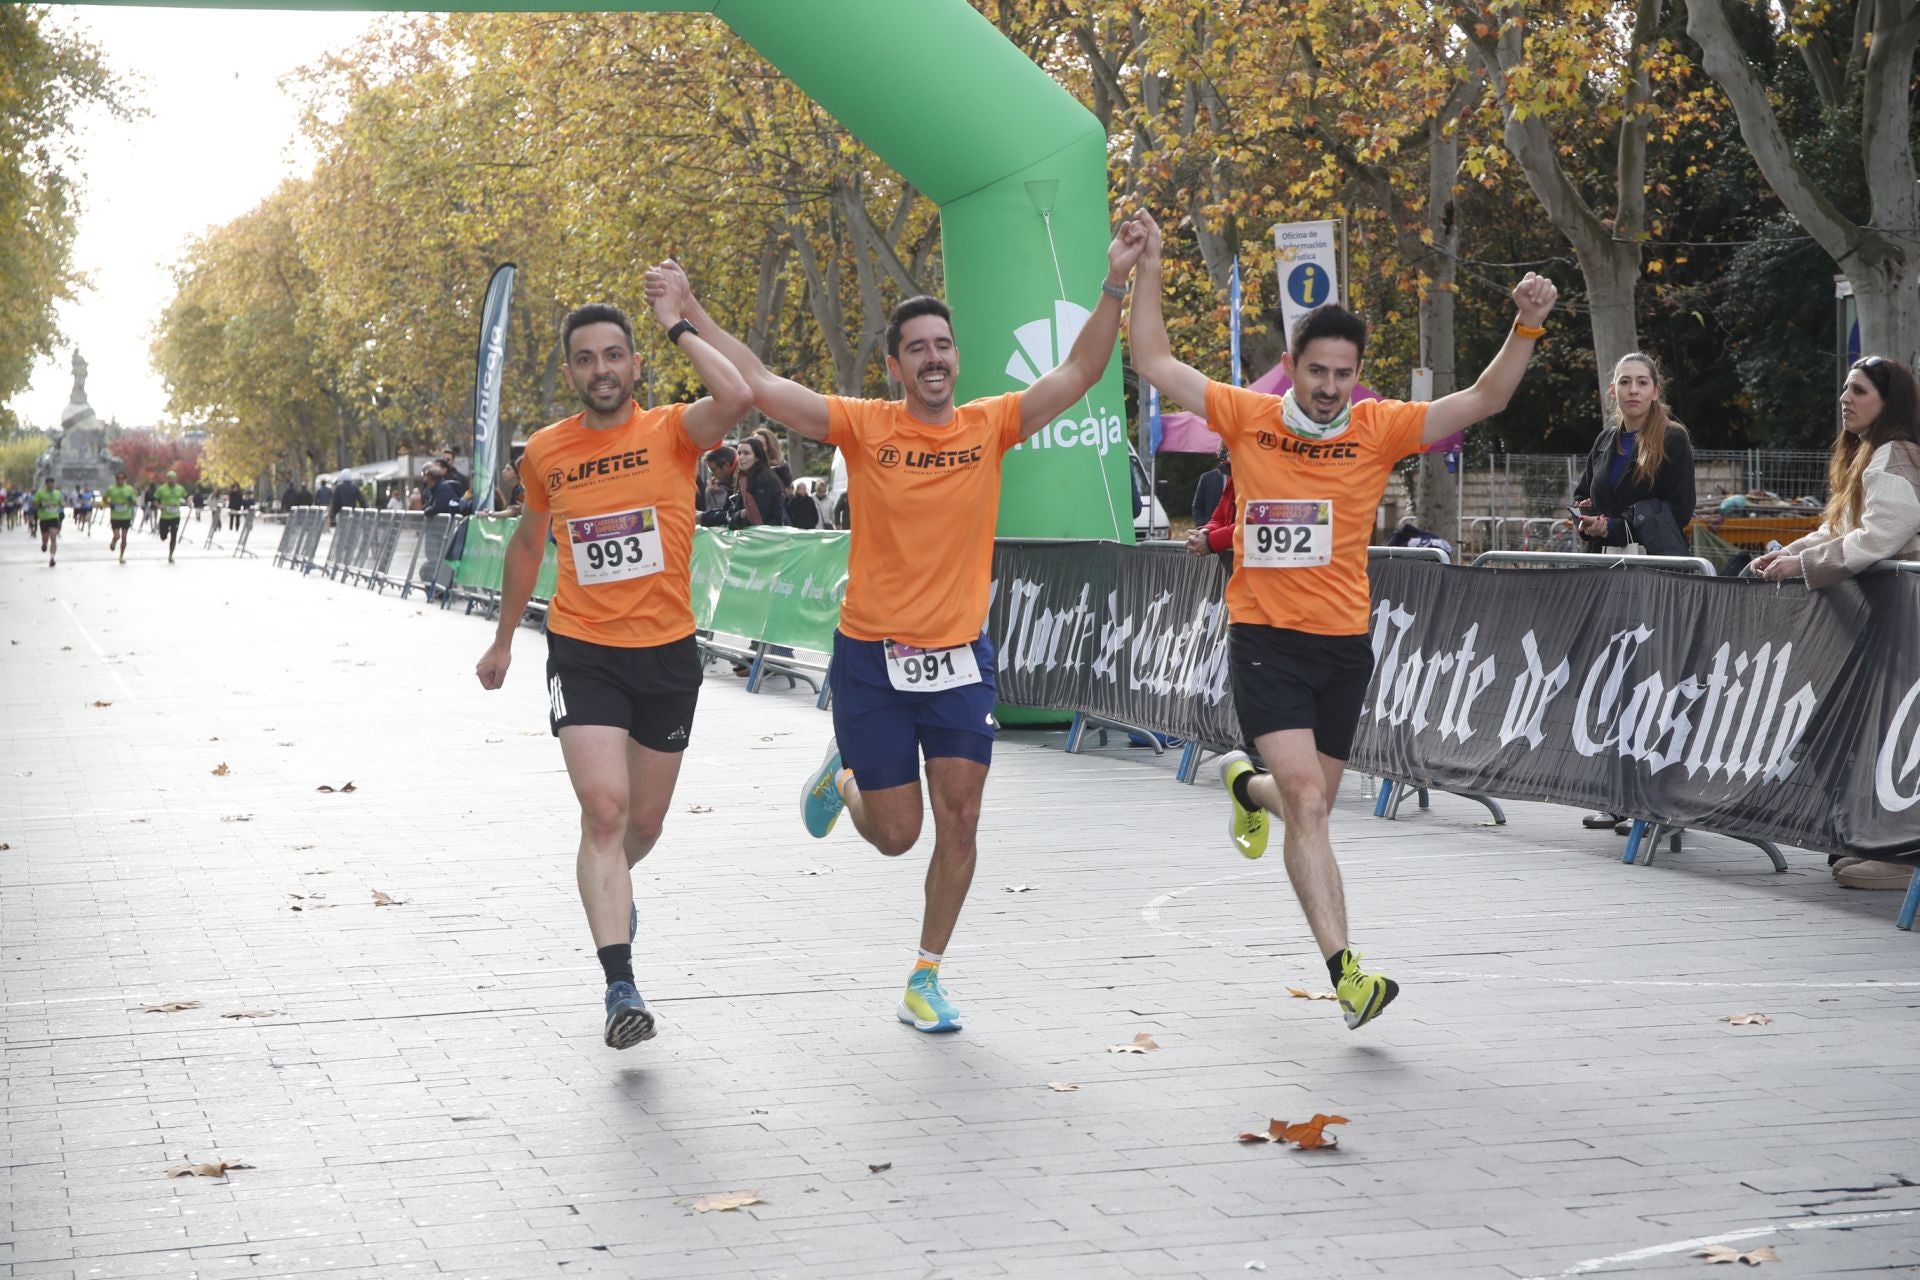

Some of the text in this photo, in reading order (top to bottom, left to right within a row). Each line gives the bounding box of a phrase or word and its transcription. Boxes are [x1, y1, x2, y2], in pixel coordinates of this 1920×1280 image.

[1282, 229, 1318, 240] Oficina de
[475, 325, 504, 442] Unicaja
[1014, 406, 1122, 456] icaja
[1258, 431, 1359, 459] ZF LIFETEC
[567, 448, 649, 482] LIFETEC
[880, 445, 982, 469] ZF LIFETEC
[587, 537, 643, 569] 993
[1257, 526, 1312, 553] 992
[997, 578, 1096, 675] Norte
[903, 652, 955, 684] 991
[1360, 598, 1496, 745] Norte
[1497, 629, 1570, 751] de
[1572, 622, 1817, 786] Castilla
